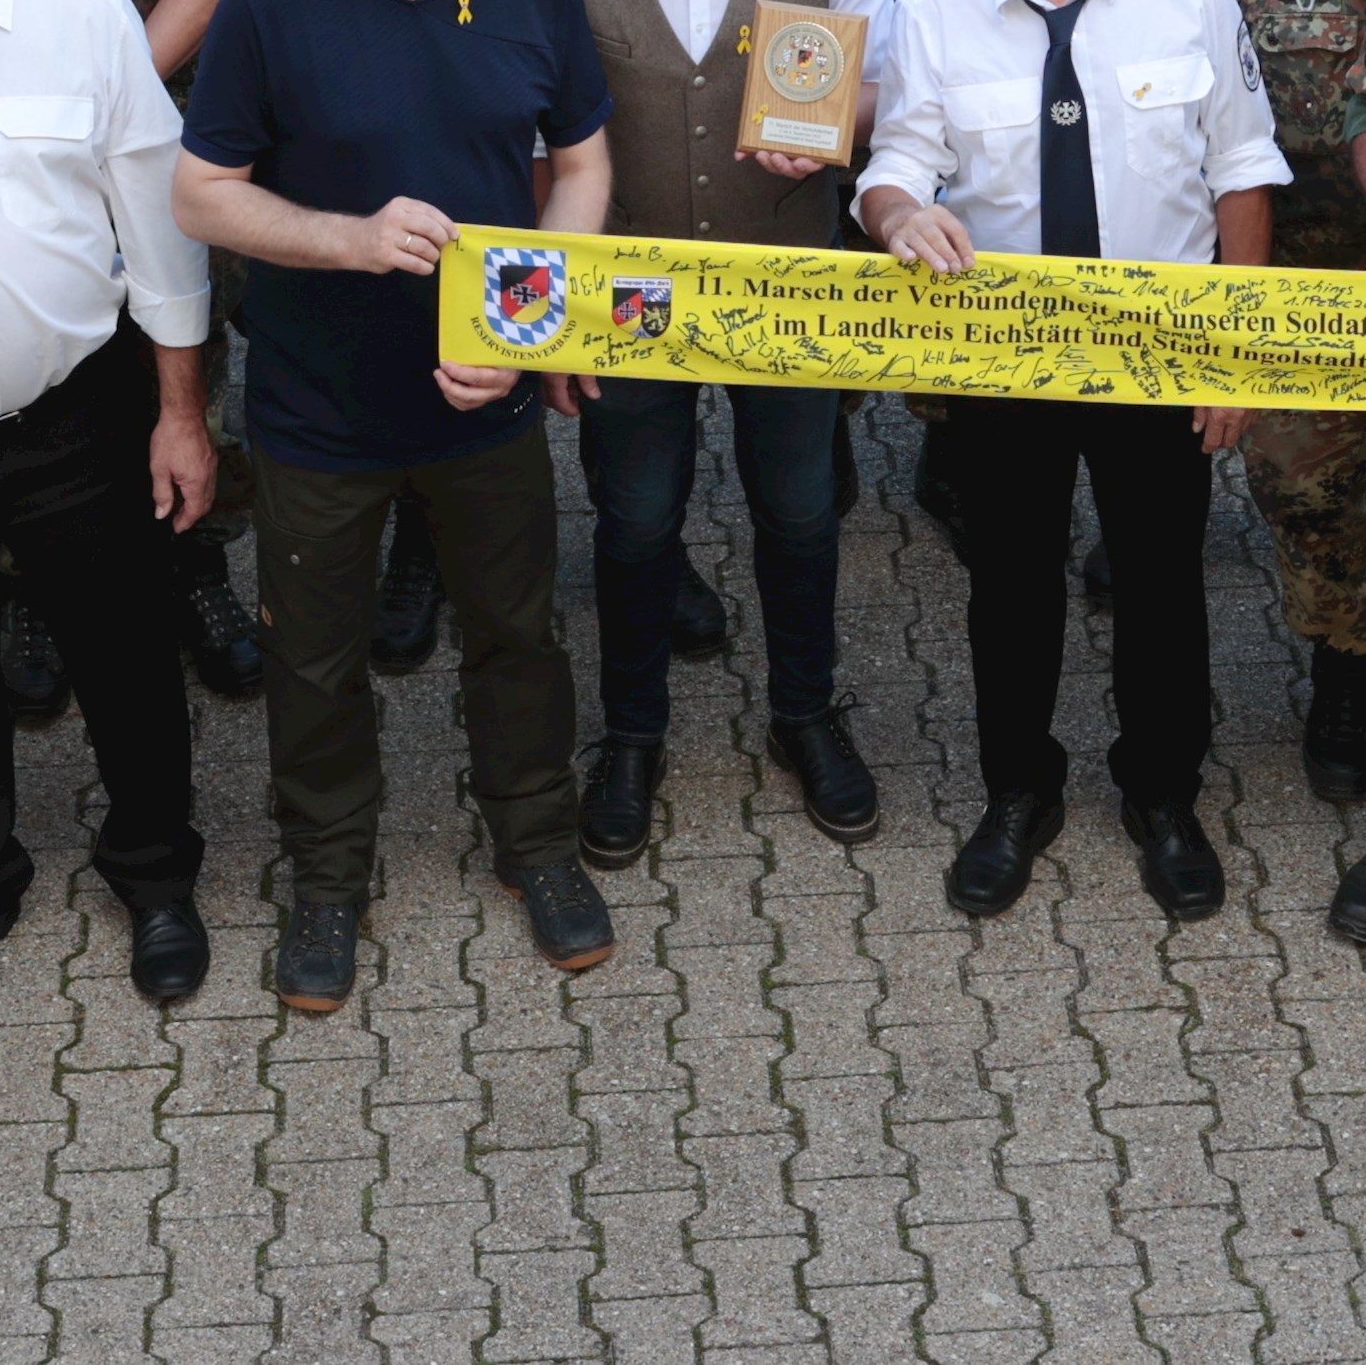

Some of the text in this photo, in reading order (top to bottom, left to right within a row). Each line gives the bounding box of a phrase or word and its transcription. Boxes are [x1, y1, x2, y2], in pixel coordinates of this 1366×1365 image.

[695, 275, 733, 297] 11.
[743, 277, 844, 301] Marsch
[853, 284, 899, 303] der
[908, 284, 1115, 317] Verbundenheit
[1119, 305, 1164, 327] mit
[1172, 312, 1277, 333] unseren
[470, 316, 578, 361] RESERVISTENVERBAND
[774, 313, 807, 336] im
[818, 314, 954, 342] Landkreis
[964, 321, 1083, 345] Eichstätt
[1092, 331, 1142, 348] und
[1151, 335, 1222, 357] Stadt
